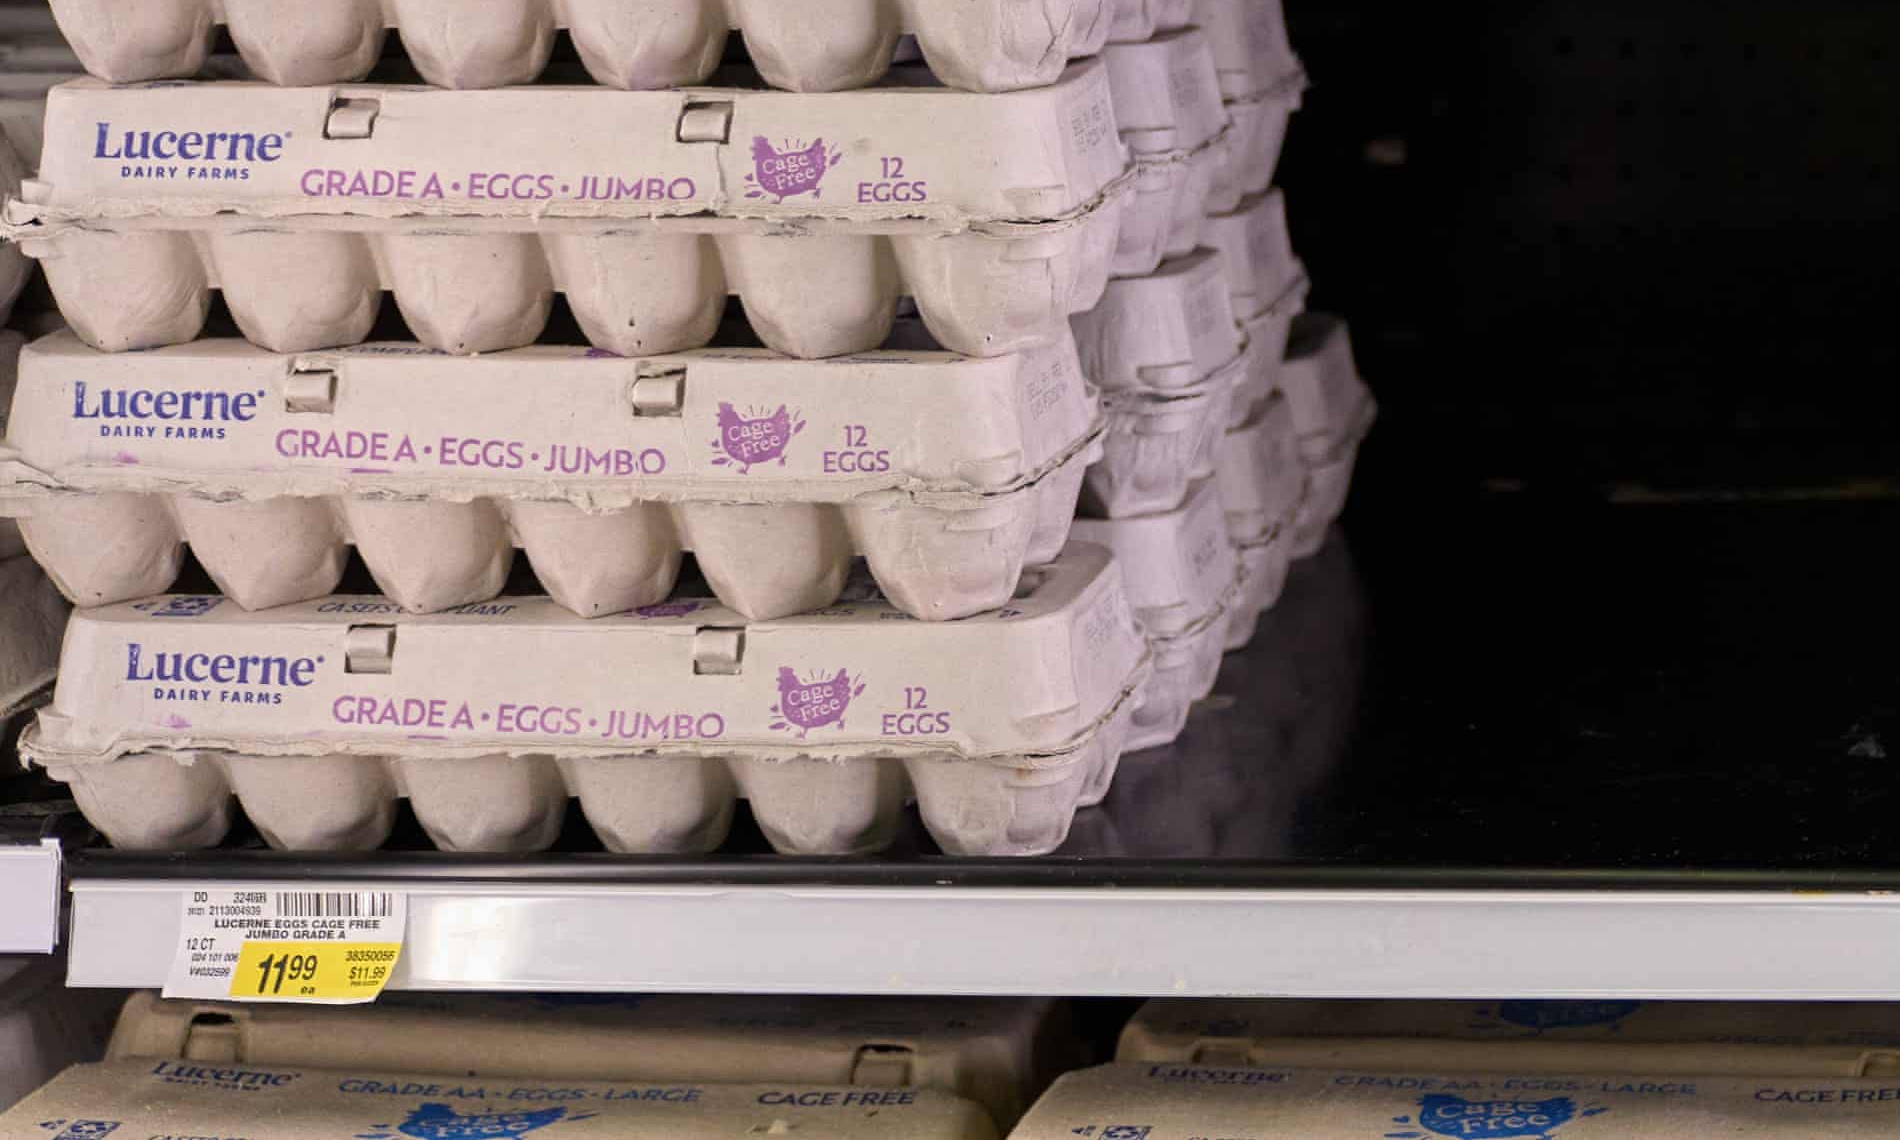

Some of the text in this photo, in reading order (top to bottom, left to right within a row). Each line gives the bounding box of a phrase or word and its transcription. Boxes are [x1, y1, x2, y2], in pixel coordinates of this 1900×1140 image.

[94, 121, 283, 162] Lucerne
[121, 166, 250, 180] DAIRY FARMS
[762, 152, 809, 174] Cage
[880, 157, 904, 179] 12
[300, 169, 697, 200] GRADE A EGGS JUMBO
[774, 167, 817, 191] Free
[857, 181, 927, 204] EGGS
[72, 381, 257, 421] Lucerne
[100, 425, 226, 440] DAIRY FARMS
[727, 420, 774, 442] Cage
[844, 426, 867, 446] 12
[276, 429, 667, 476] GRADE A EGGS JUMBO
[739, 434, 781, 458] Free
[823, 451, 890, 473] EGGS
[126, 643, 315, 686] Lucerne
[154, 688, 282, 704] DAIRY FARMS
[787, 684, 834, 706] Cage
[904, 688, 927, 709] 12
[333, 695, 726, 740] GRADE A EGGS JUMBO
[800, 698, 840, 722] Free
[882, 713, 951, 736] EGGS
[214, 919, 380, 929] LUCERNE EGGS CAGE FREE
[245, 930, 346, 939] JUMBO GRADE A
[187, 939, 215, 950] 12 CT
[349, 967, 386, 980] $11.99
[152, 1061, 293, 1085] Lucerne
[339, 1079, 916, 1106] GRADE AA EGGS LARGE CAGE FREE
[1754, 1088, 1835, 1103] CAGE
[1460, 1114, 1550, 1134] Free
